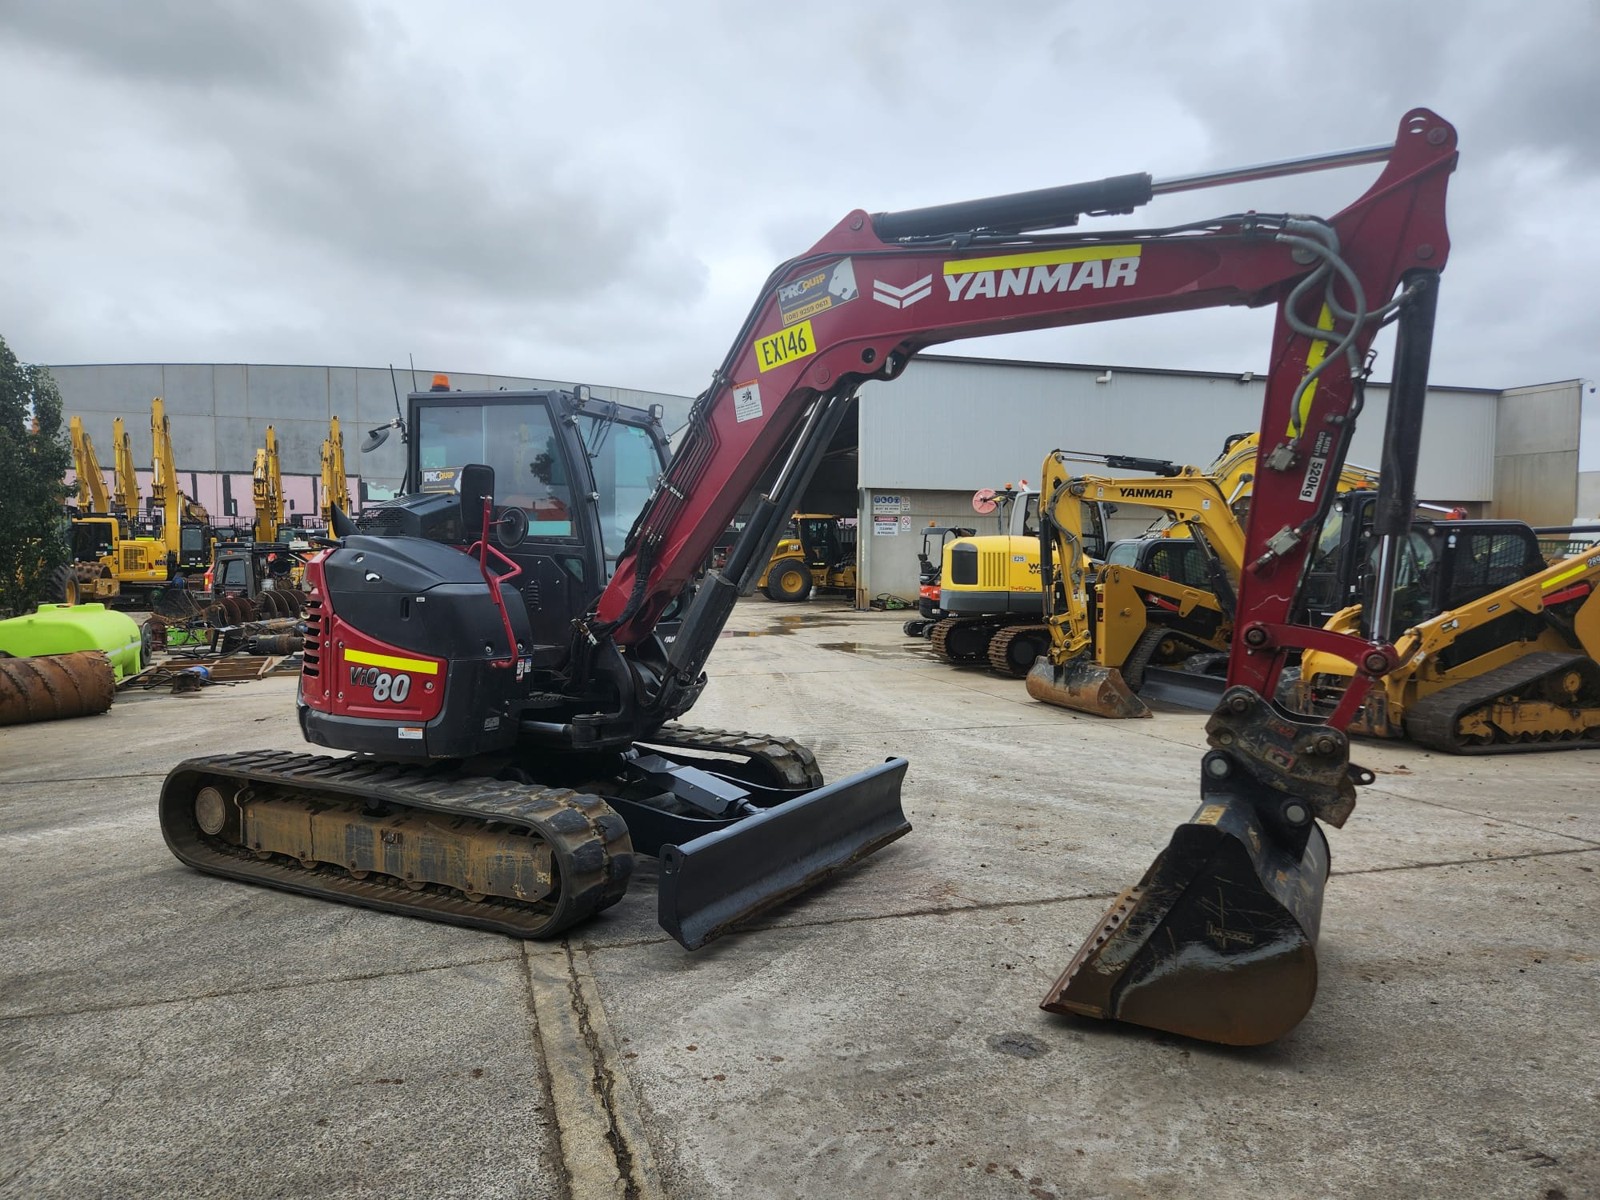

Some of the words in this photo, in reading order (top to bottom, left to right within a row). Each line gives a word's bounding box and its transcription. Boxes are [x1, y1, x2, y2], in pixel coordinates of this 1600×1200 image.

[778, 273, 826, 302] PROQUIP
[944, 256, 1141, 302] YANMAR
[762, 327, 807, 365] EX146
[1119, 487, 1173, 499] YANMAR
[1302, 461, 1323, 498] 520kg
